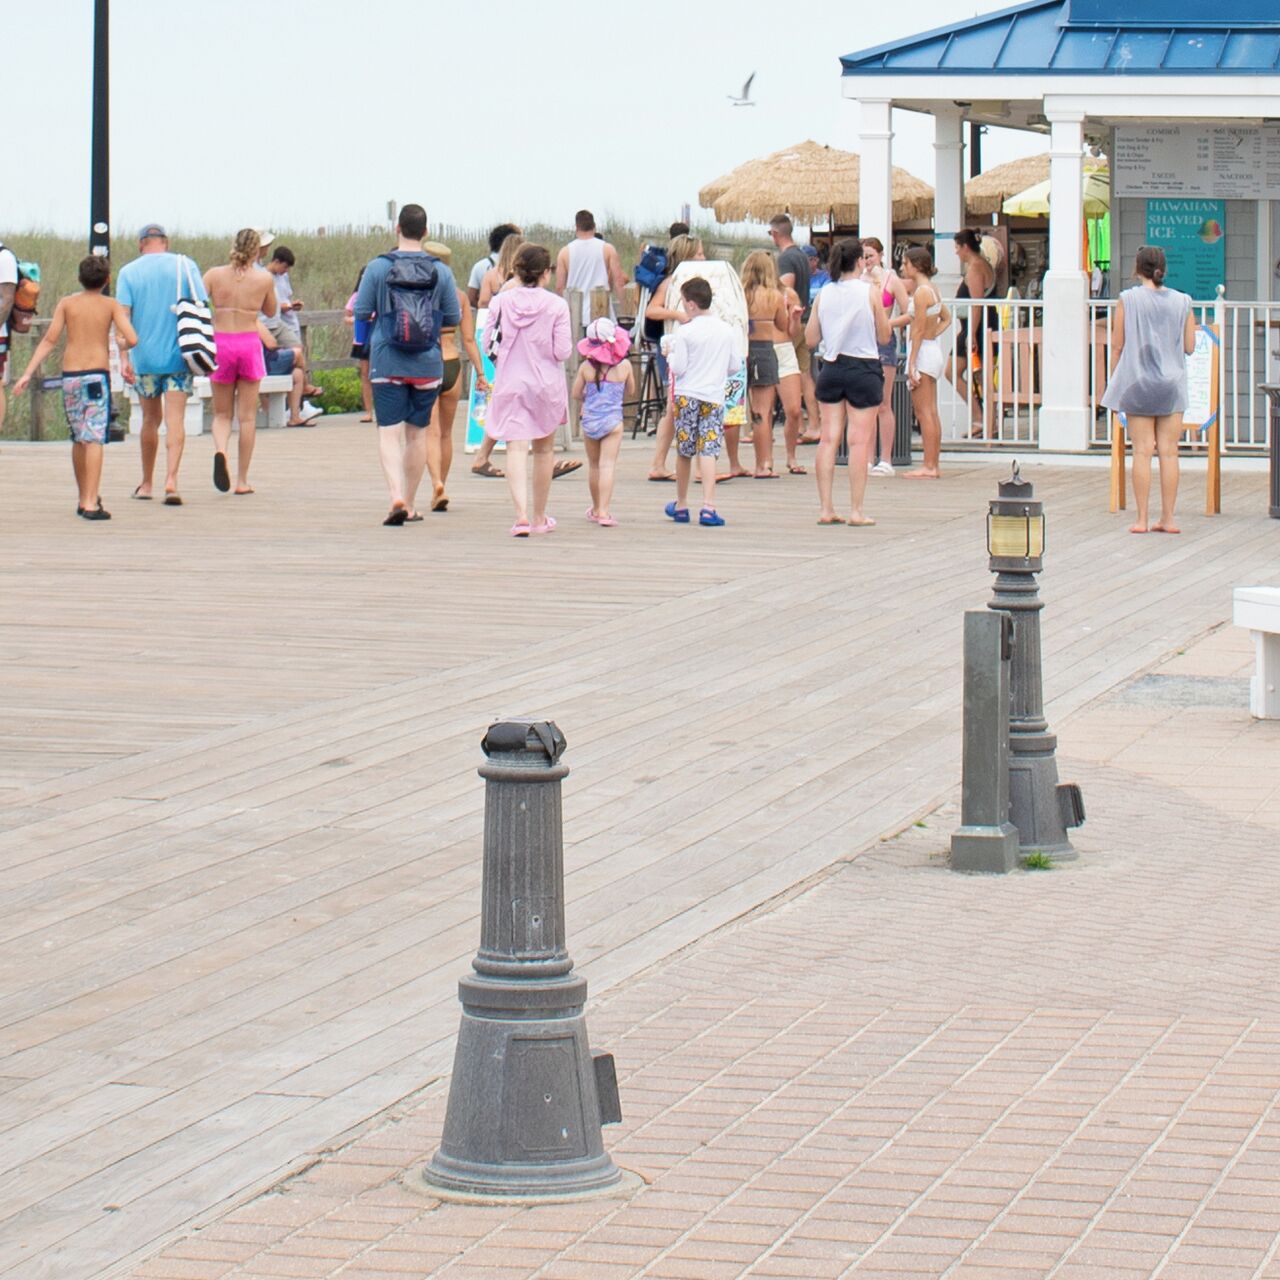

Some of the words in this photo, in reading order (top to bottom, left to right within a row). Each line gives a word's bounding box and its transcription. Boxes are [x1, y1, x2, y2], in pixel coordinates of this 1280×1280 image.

[1148, 201, 1219, 212] HAWAIIAN
[1148, 214, 1204, 225] SHAVED
[1149, 226, 1177, 239] ICE
